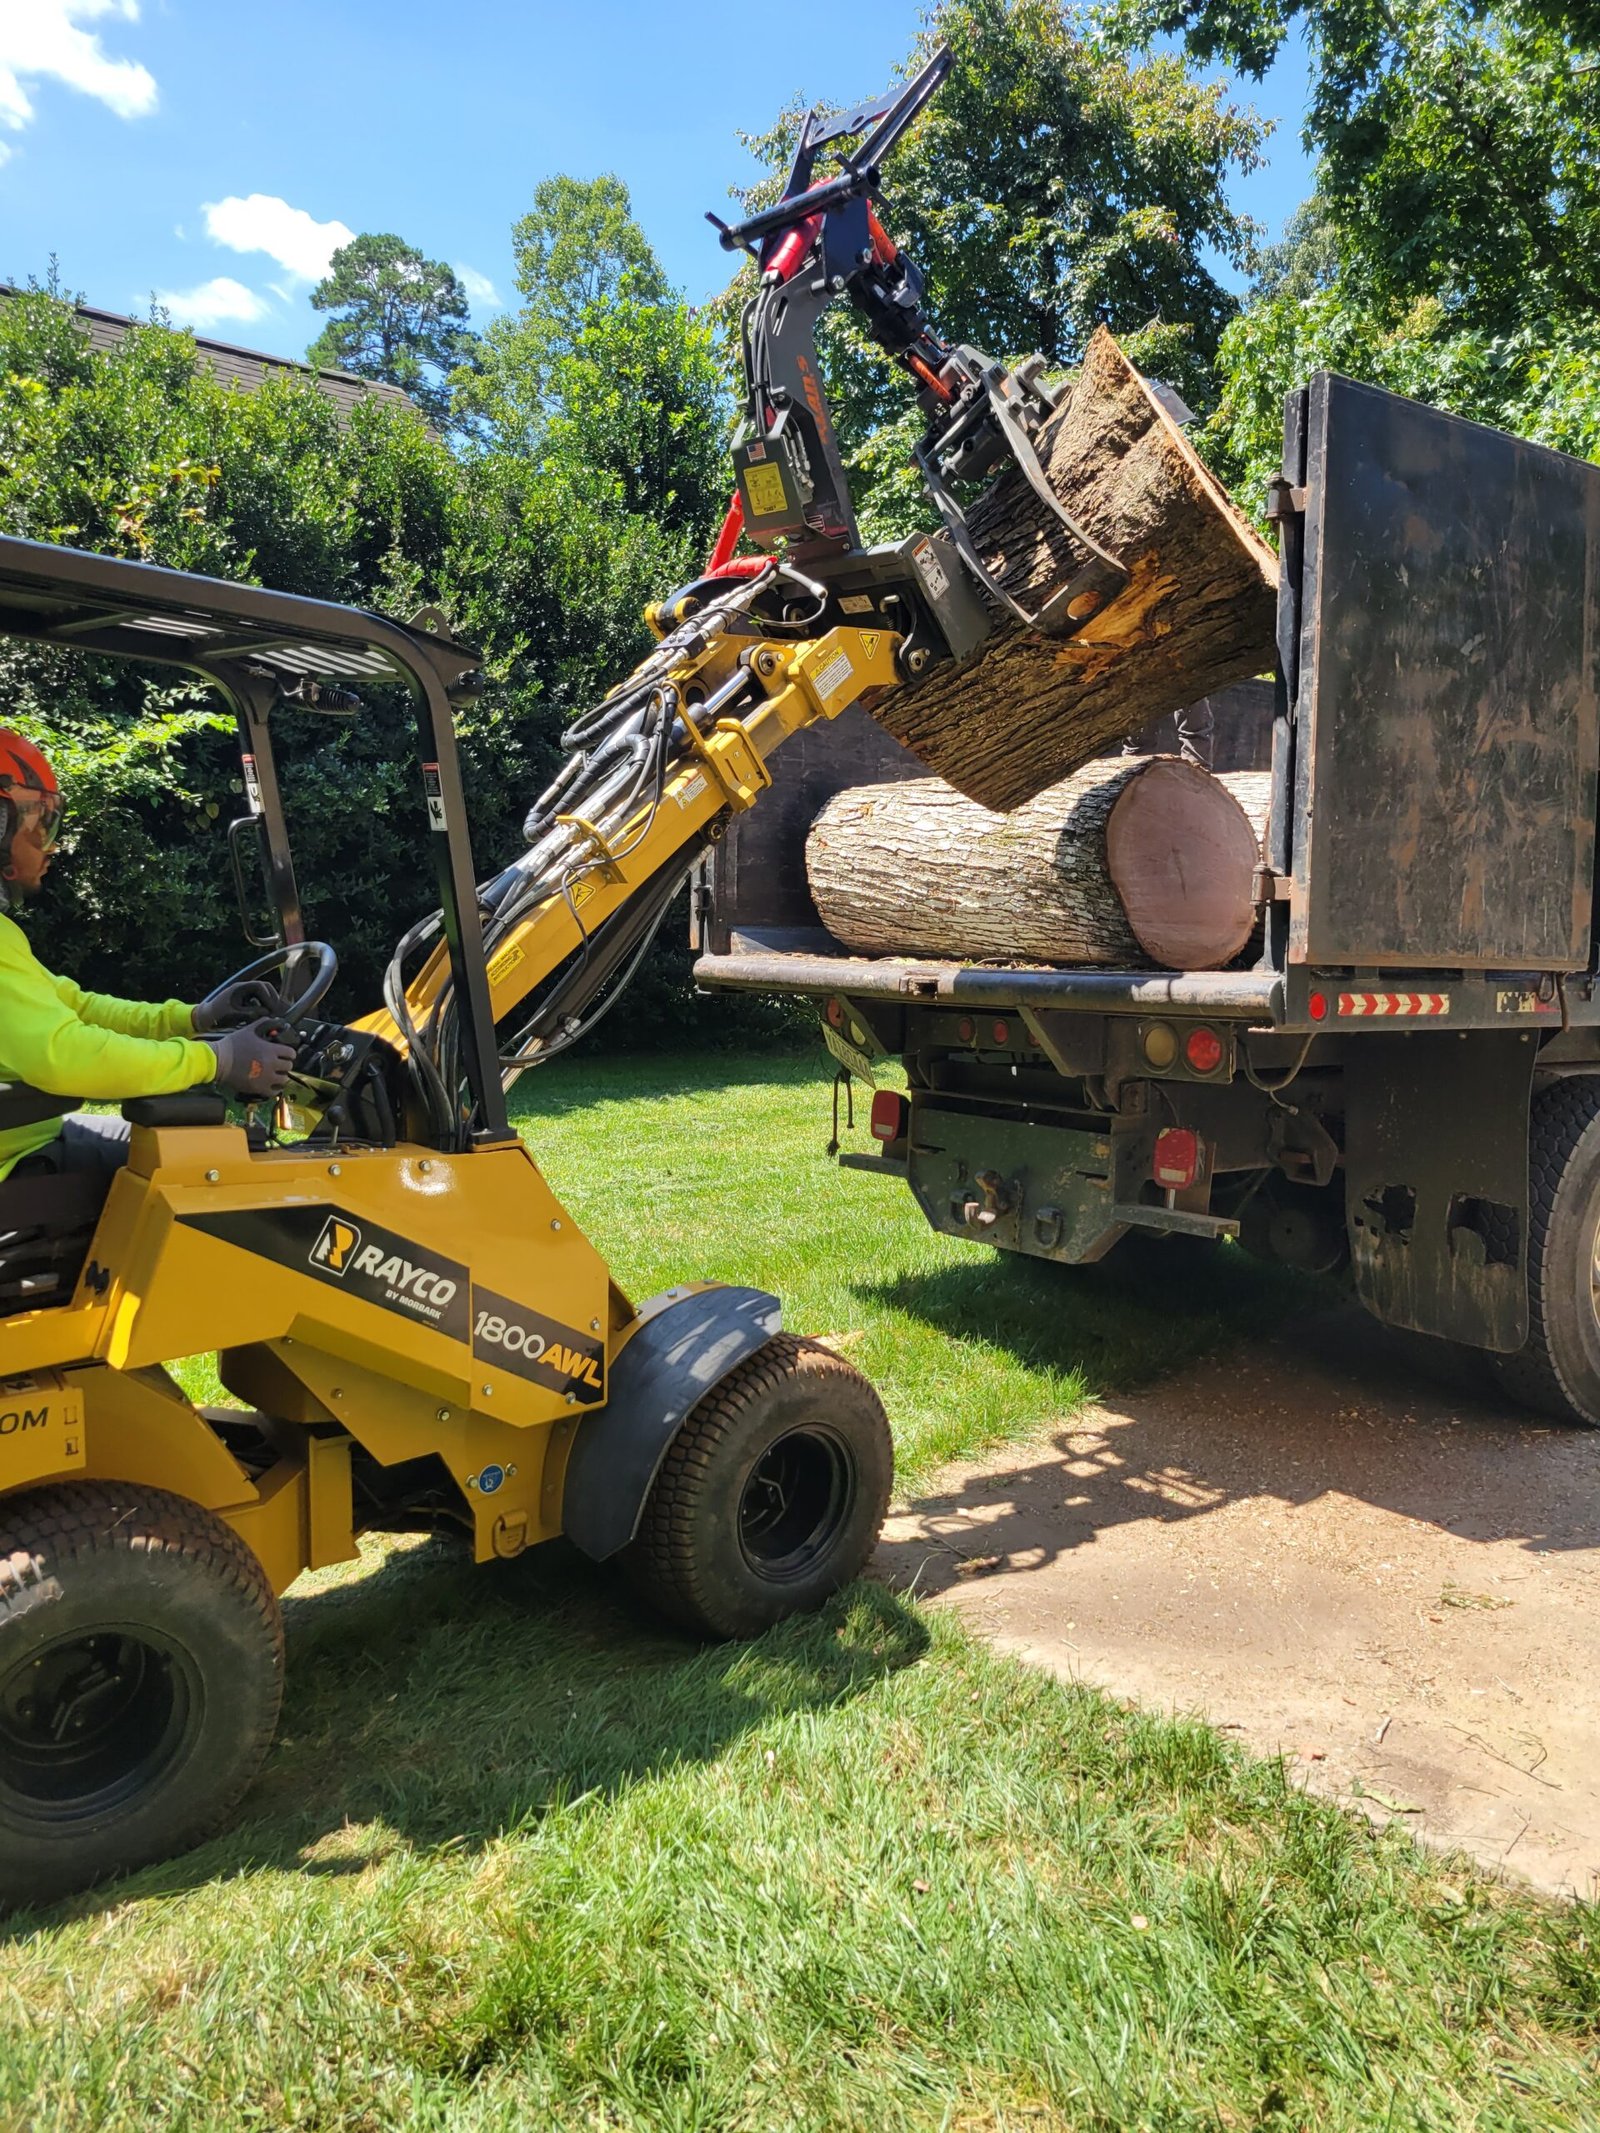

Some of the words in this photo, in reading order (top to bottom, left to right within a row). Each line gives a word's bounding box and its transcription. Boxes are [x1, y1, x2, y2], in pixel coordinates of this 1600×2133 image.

[353, 1244, 457, 1306] RAYCO
[385, 1289, 399, 1300] BY
[399, 1295, 442, 1319] MORBARK
